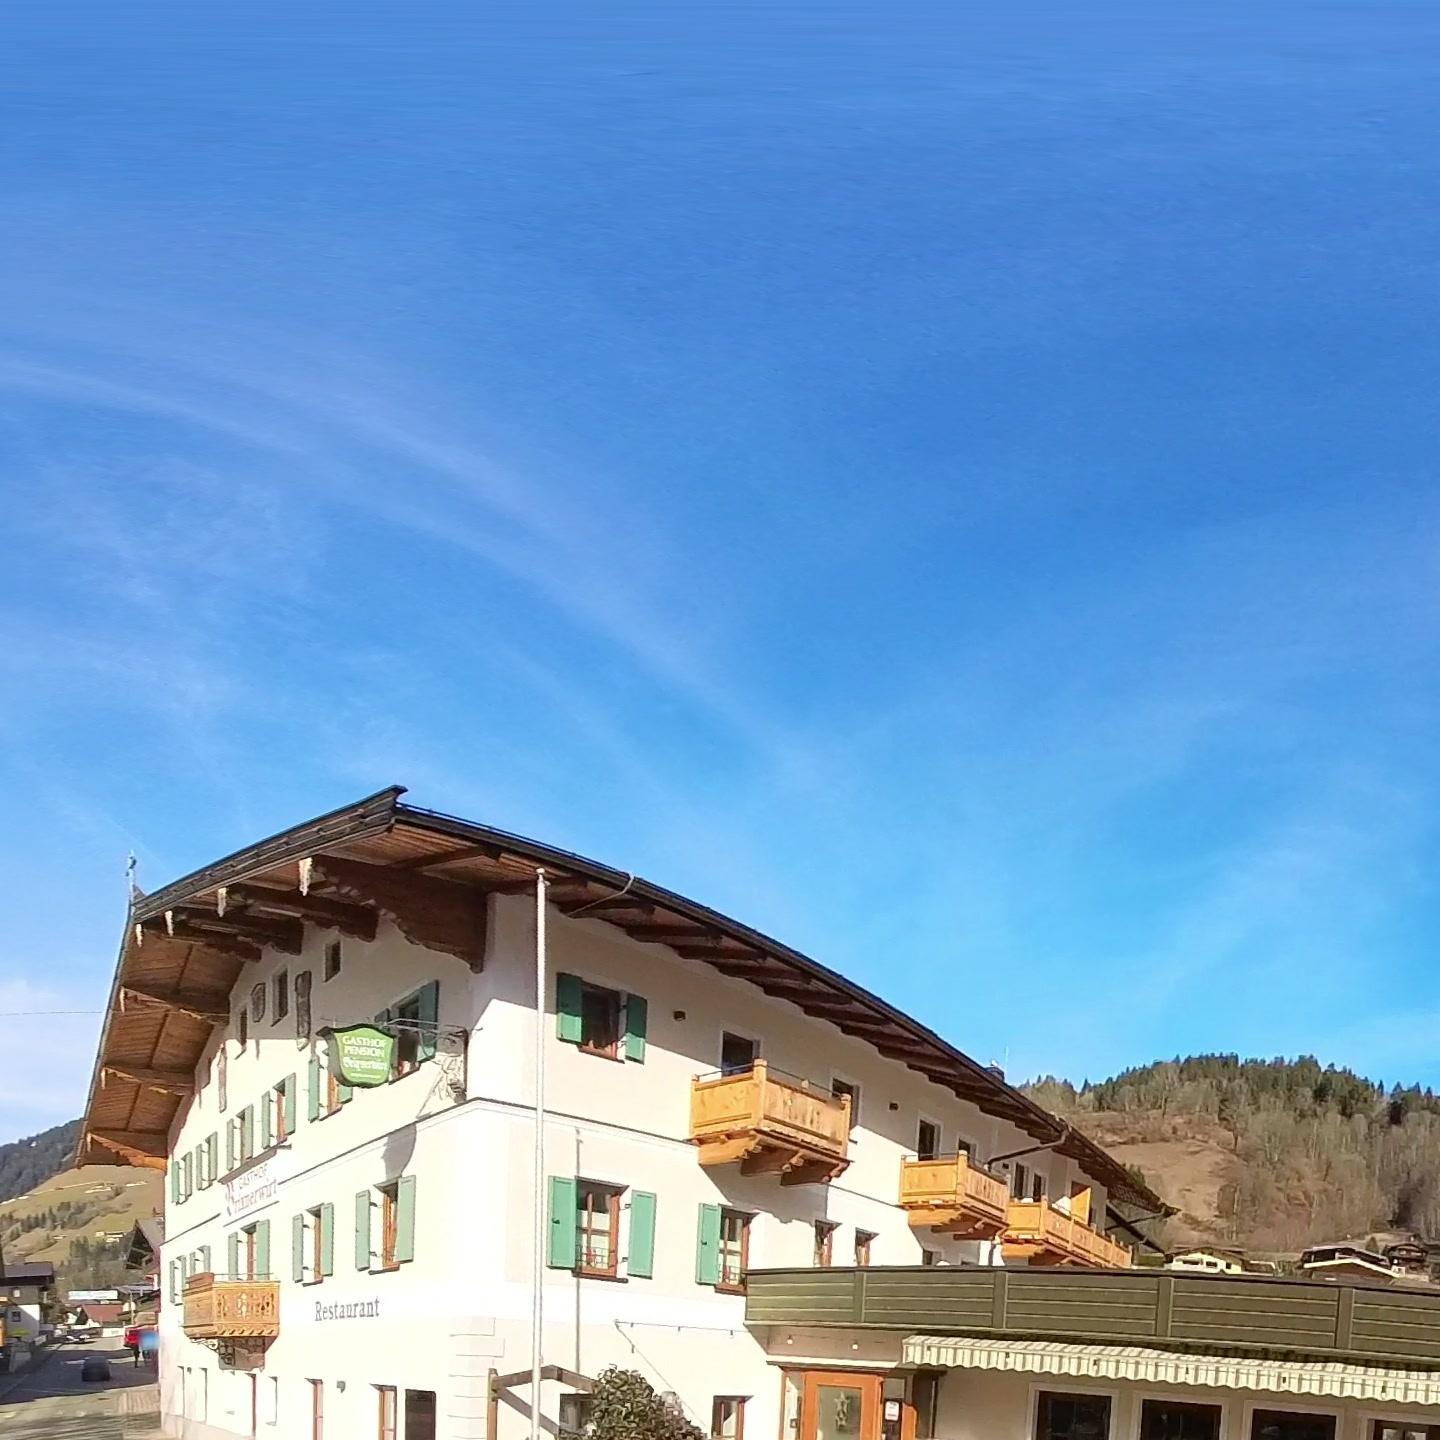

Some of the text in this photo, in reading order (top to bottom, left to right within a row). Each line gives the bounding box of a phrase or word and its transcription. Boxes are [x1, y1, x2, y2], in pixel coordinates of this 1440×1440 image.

[342, 1035, 386, 1048] GASTHOF
[343, 1046, 385, 1058] PENSION
[315, 1297, 380, 1321] Restaurant
